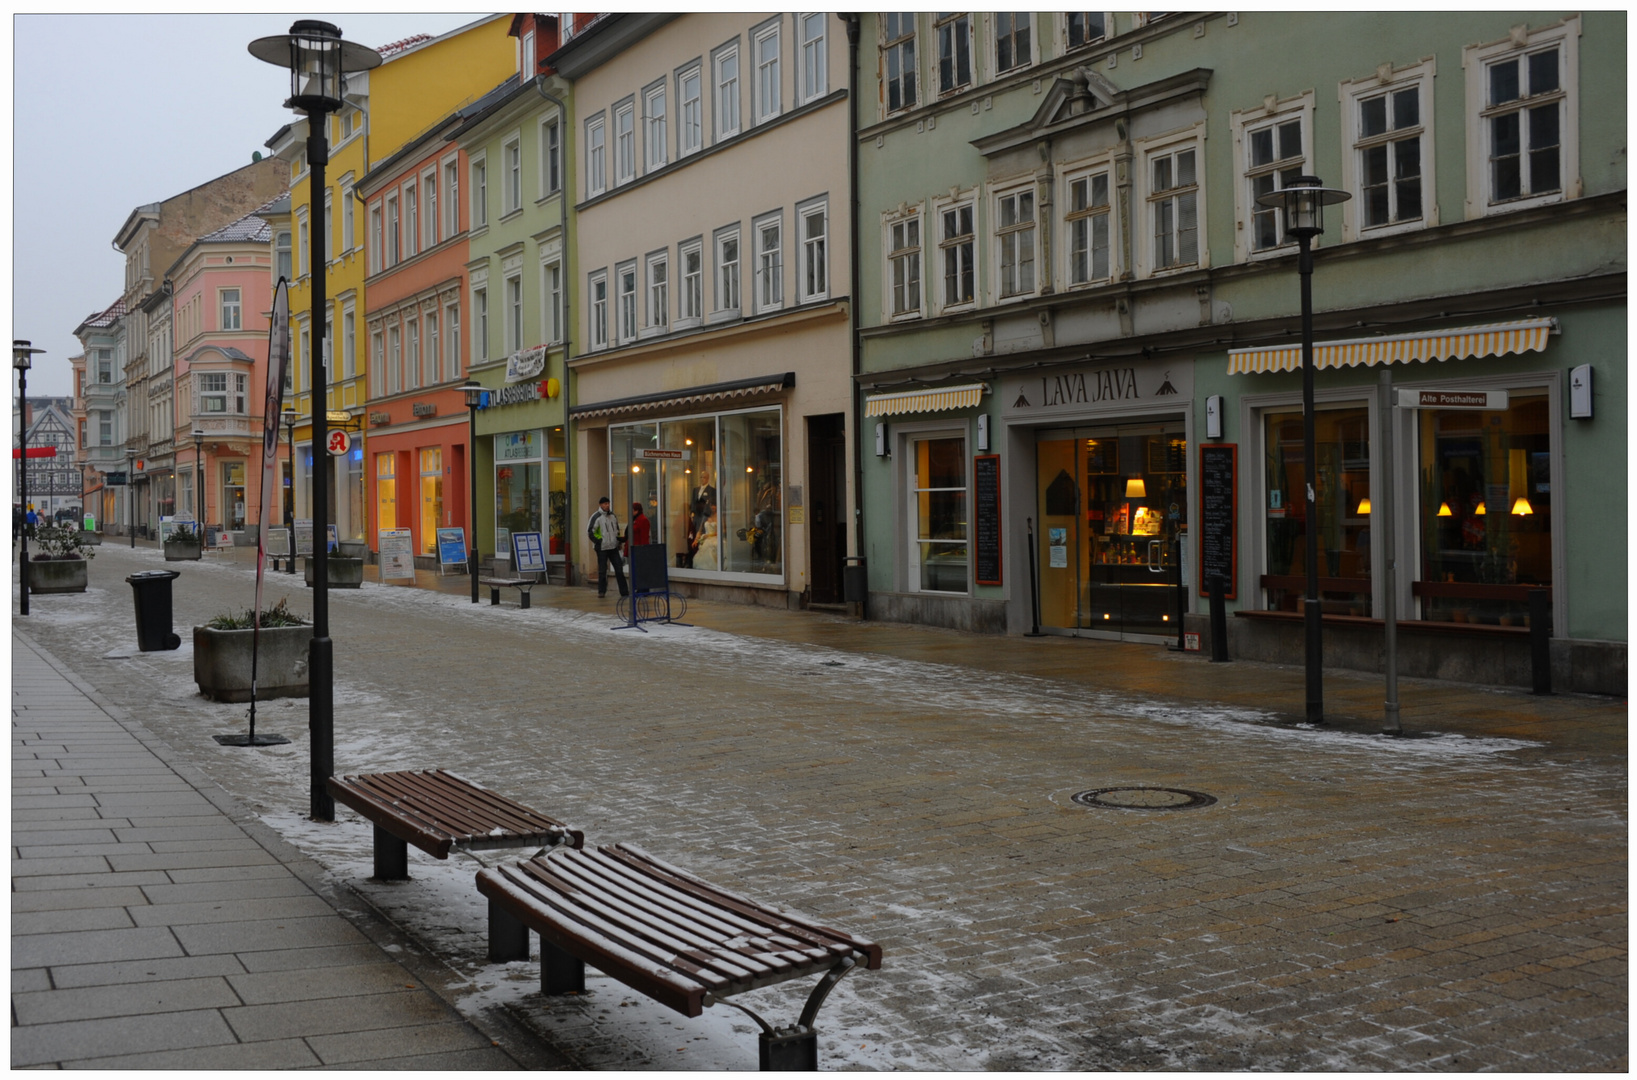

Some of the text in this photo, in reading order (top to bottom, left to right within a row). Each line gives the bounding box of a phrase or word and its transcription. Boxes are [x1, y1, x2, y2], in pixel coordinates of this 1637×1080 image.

[1041, 367, 1140, 407] LAVA JAVA
[1421, 394, 1486, 404] Alte Posthalterei
